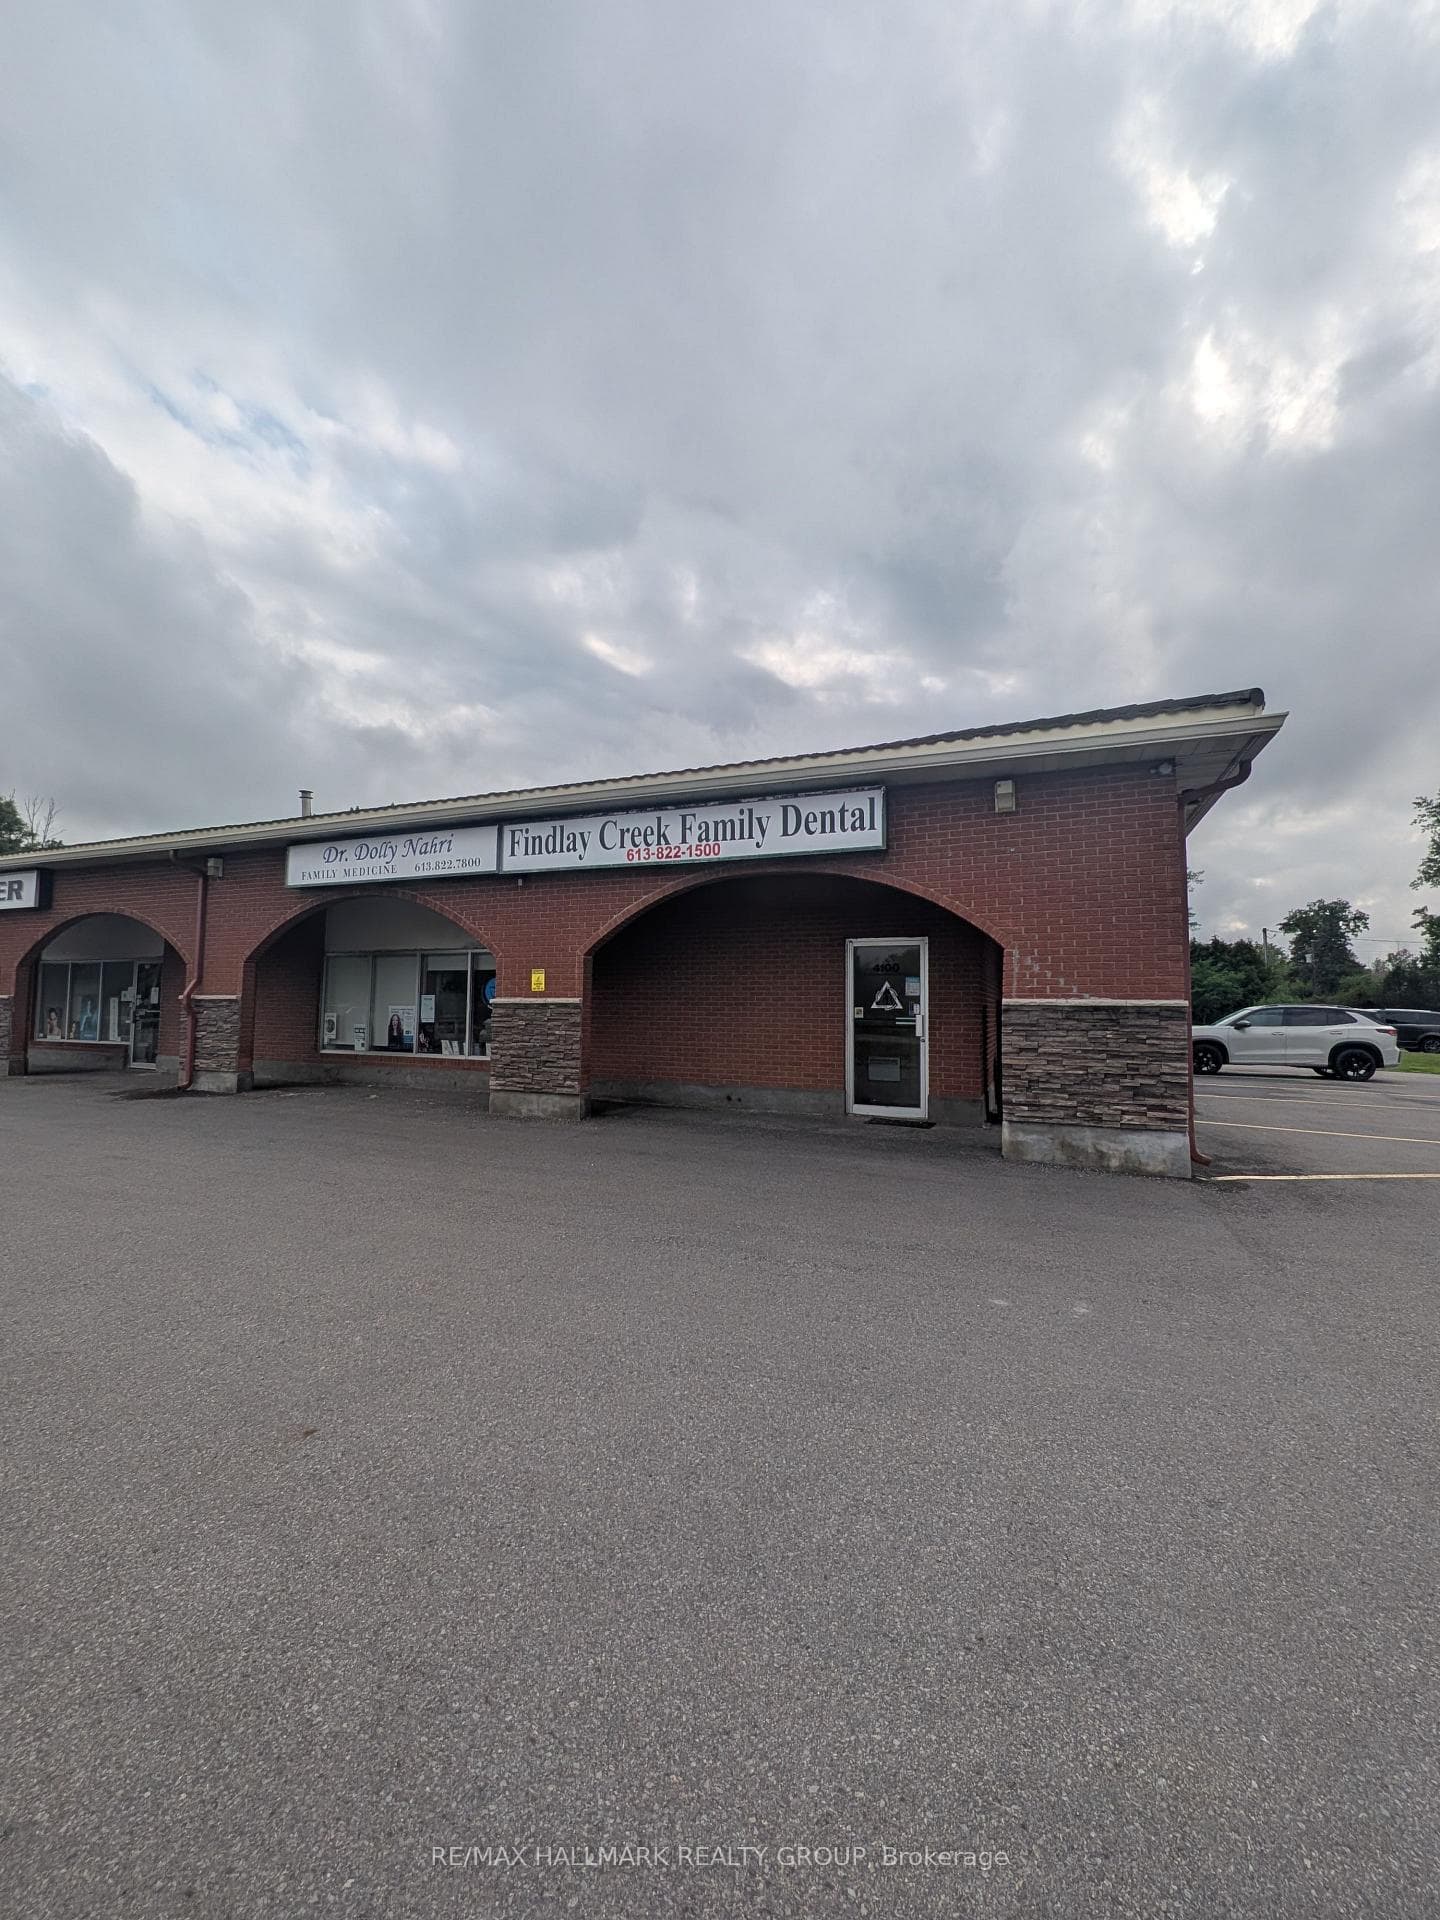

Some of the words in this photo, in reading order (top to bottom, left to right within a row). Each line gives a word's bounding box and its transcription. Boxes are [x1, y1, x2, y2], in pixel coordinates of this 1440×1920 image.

[509, 825, 591, 860] Findlay
[600, 816, 671, 851] Creek
[679, 807, 771, 848] Family
[780, 797, 877, 837] Dental
[323, 846, 348, 864] Dr.
[354, 841, 398, 864] Dolly
[401, 833, 454, 858] Nahri
[626, 843, 721, 861] 613-822-1500
[301, 869, 337, 881] FAMILY
[343, 864, 397, 878] MEDICINE
[414, 857, 481, 872] 613.822.7800
